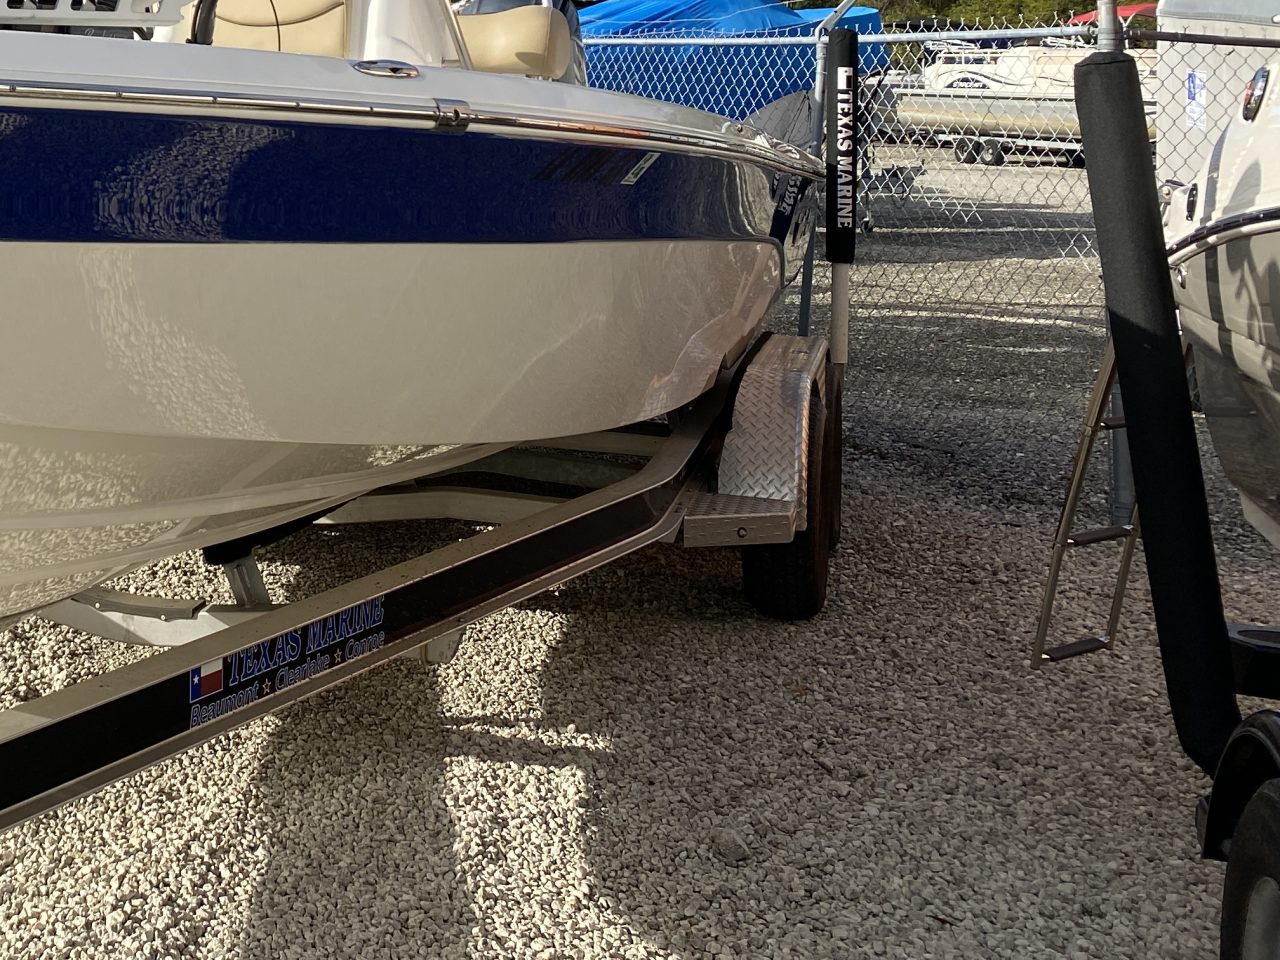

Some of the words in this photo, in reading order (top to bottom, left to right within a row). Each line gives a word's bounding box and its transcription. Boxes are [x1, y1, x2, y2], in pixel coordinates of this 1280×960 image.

[837, 91, 854, 155] TEXAS
[837, 155, 854, 228] MARINE
[189, 680, 260, 730] Beaumont
[275, 652, 330, 692] Clearlake
[345, 630, 386, 662] Conroe
[227, 628, 302, 687] TEXAS
[306, 595, 385, 655] MARINE
